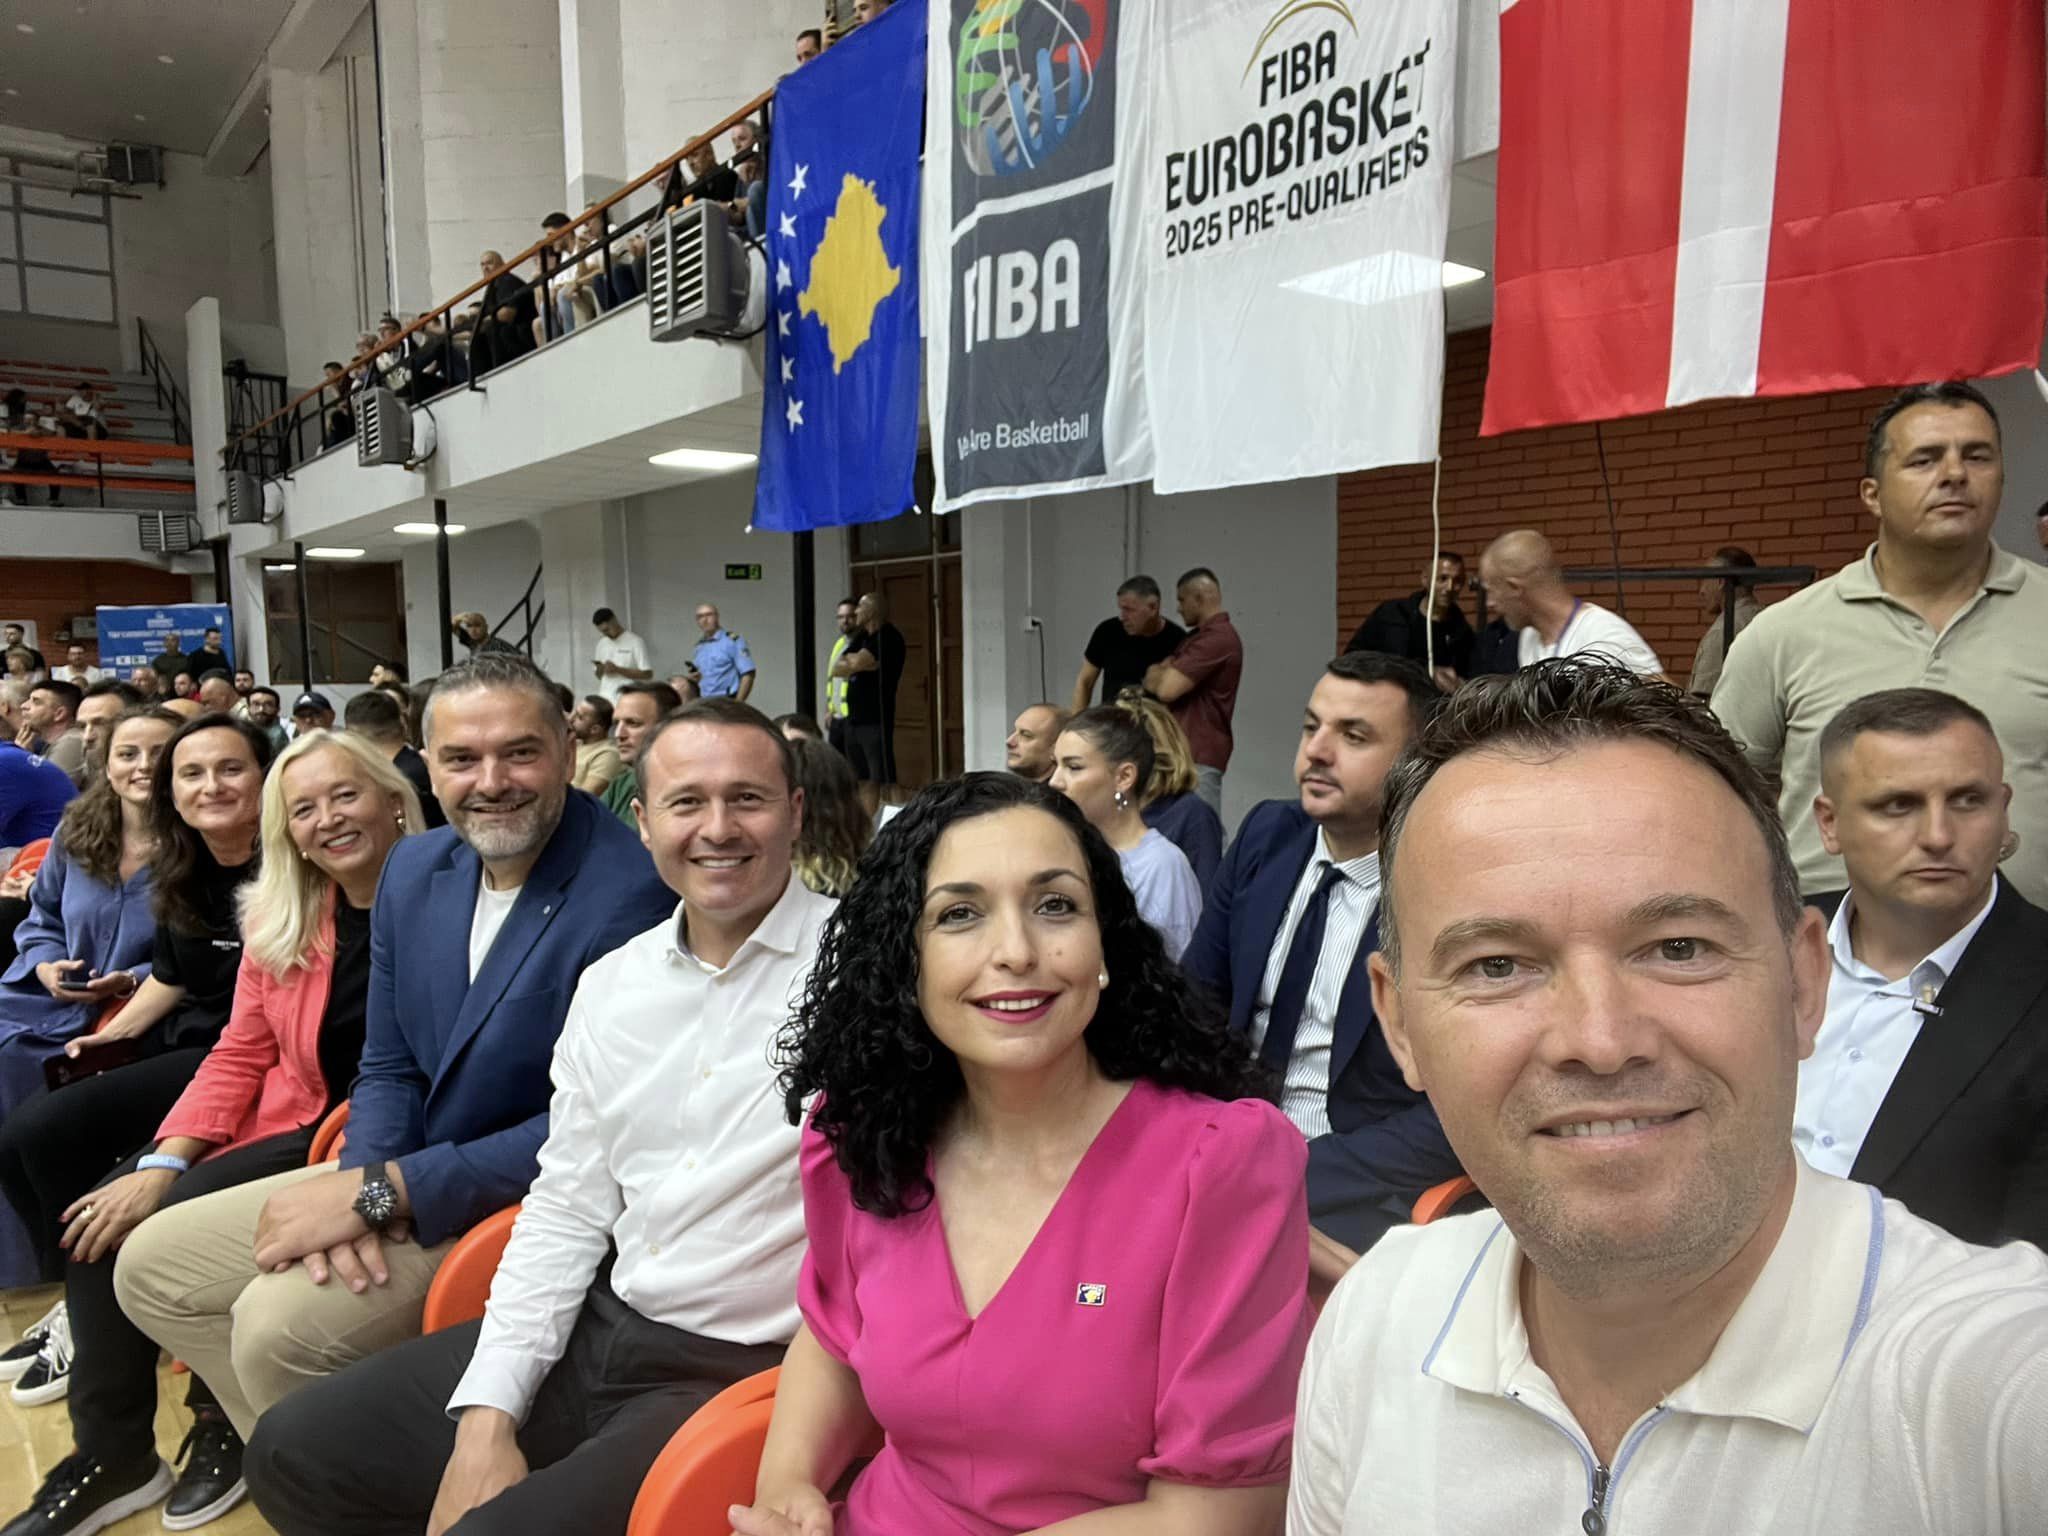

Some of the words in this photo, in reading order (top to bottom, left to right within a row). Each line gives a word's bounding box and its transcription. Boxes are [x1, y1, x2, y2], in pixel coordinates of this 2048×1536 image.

[1260, 29, 1338, 108] FIBA
[1165, 210, 1222, 259] 2025
[995, 410, 1090, 449] Basketball
